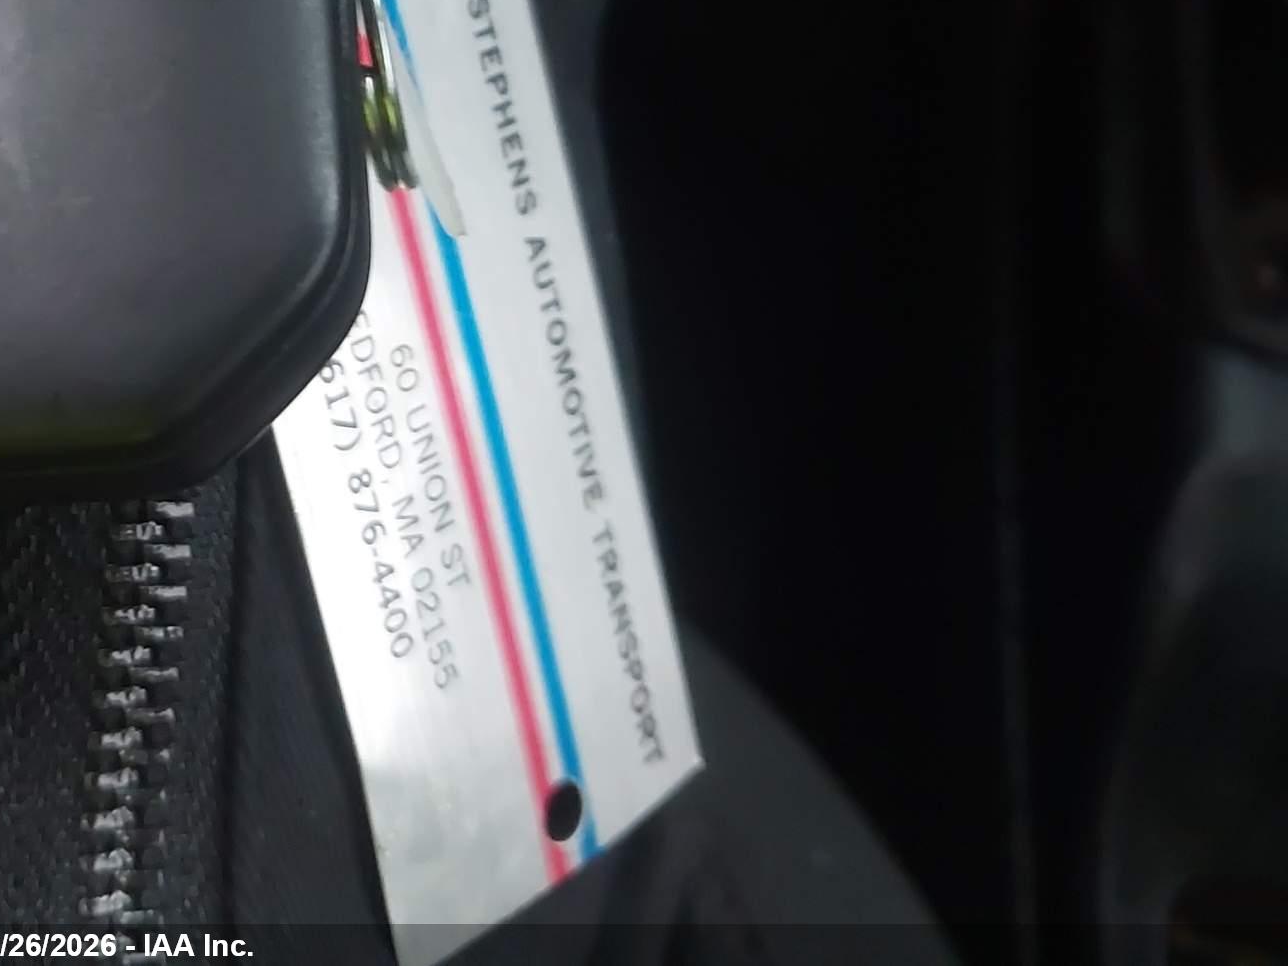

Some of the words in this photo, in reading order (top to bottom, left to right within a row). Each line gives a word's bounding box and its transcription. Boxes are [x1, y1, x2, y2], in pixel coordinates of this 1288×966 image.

[347, 467, 415, 659] 876-4400
[390, 343, 419, 392] 60
[406, 403, 455, 533] UNION
[441, 542, 471, 587] ST
[524, 235, 605, 511] AUTOMOTIVE
[591, 522, 665, 766] TRANSPORT
[392, 494, 425, 559] MA
[411, 566, 460, 690] 02155
